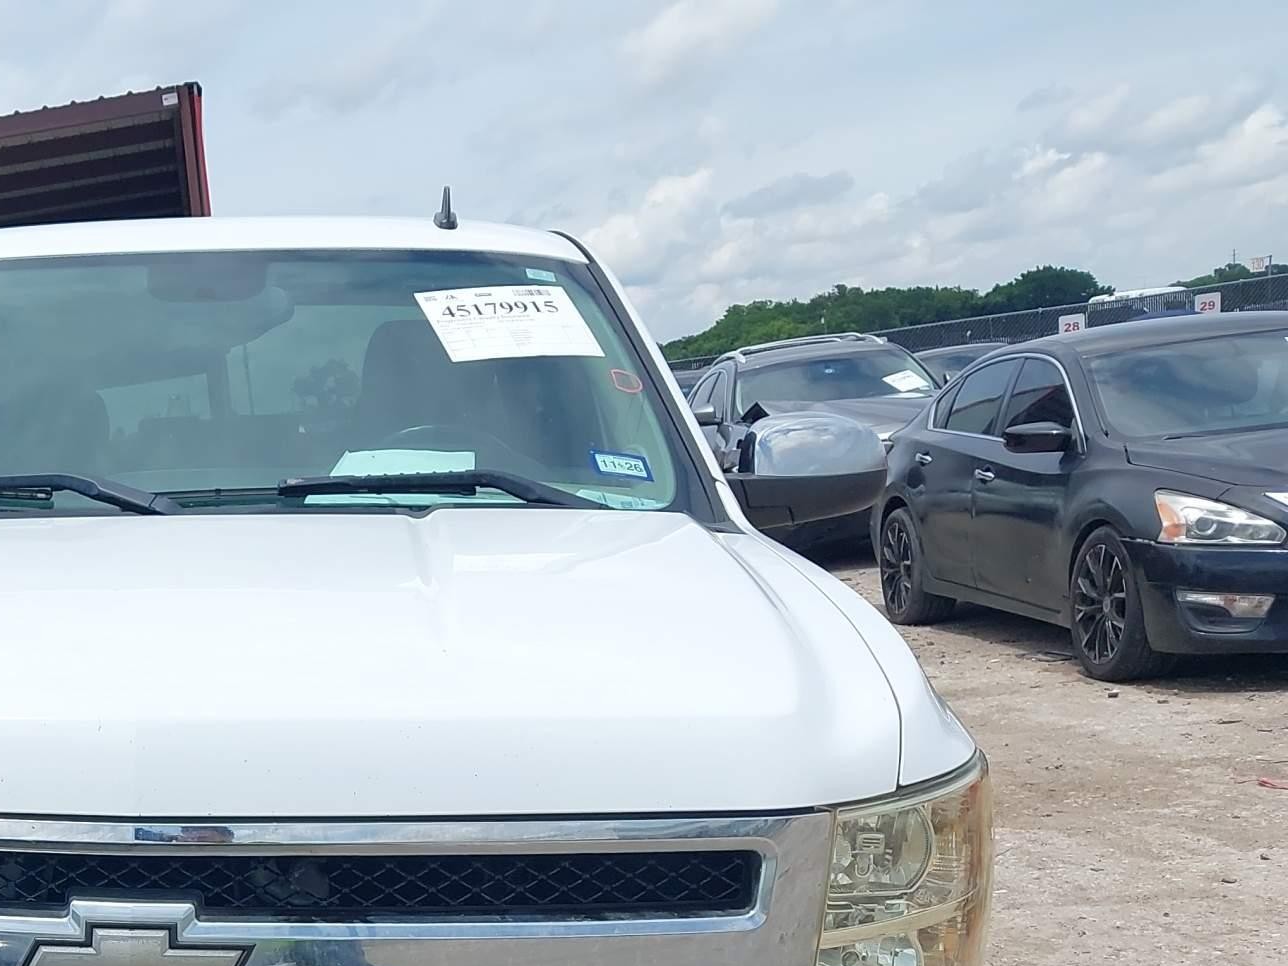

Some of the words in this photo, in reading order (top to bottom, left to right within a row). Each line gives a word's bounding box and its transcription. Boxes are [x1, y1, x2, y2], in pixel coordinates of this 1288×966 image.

[442, 301, 559, 318] 45179915
[1200, 300, 1215, 312] 29
[1064, 321, 1080, 333] 28
